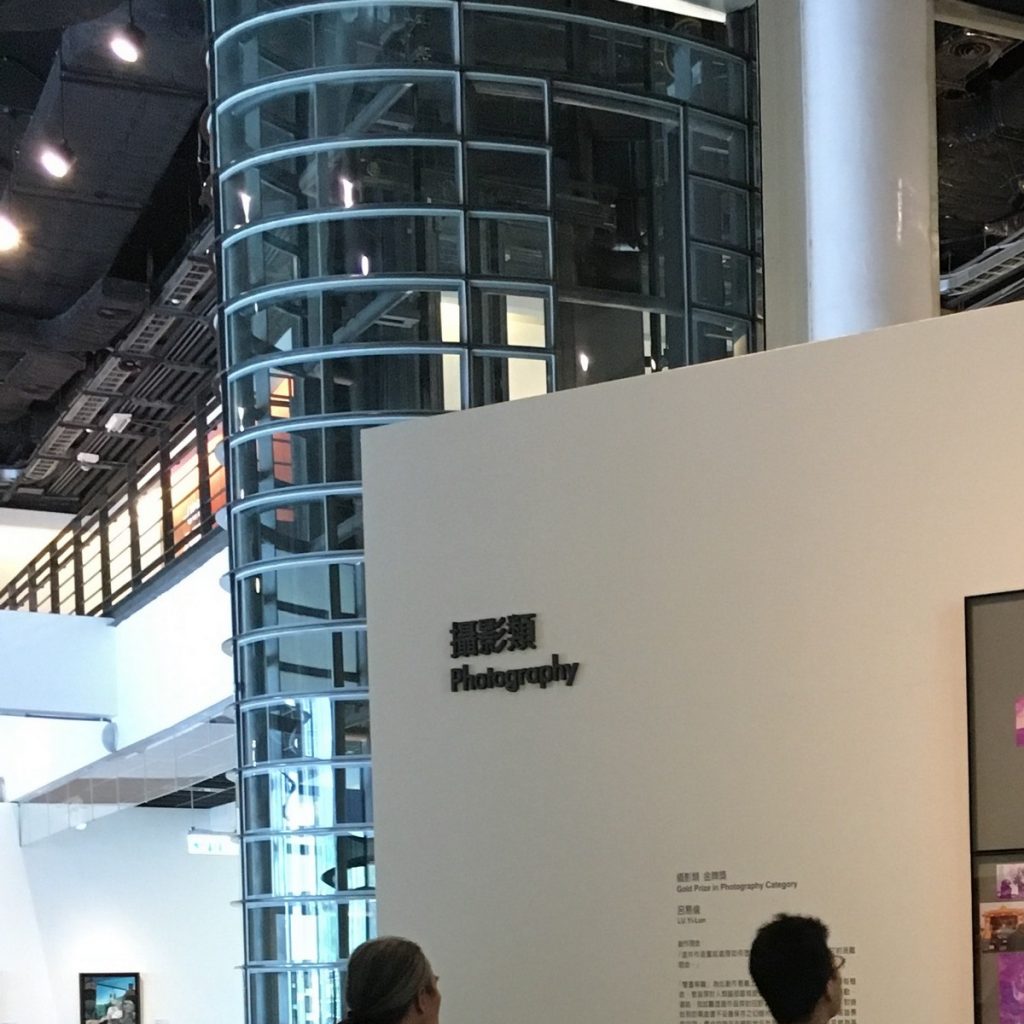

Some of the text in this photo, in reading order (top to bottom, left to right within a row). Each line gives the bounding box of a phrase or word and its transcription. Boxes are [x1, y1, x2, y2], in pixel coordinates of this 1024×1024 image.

[450, 613, 537, 659] 攝影類
[450, 653, 579, 692] Photography
[676, 884, 693, 892] Gold
[720, 882, 764, 891] Photography
[765, 880, 798, 889] Category
